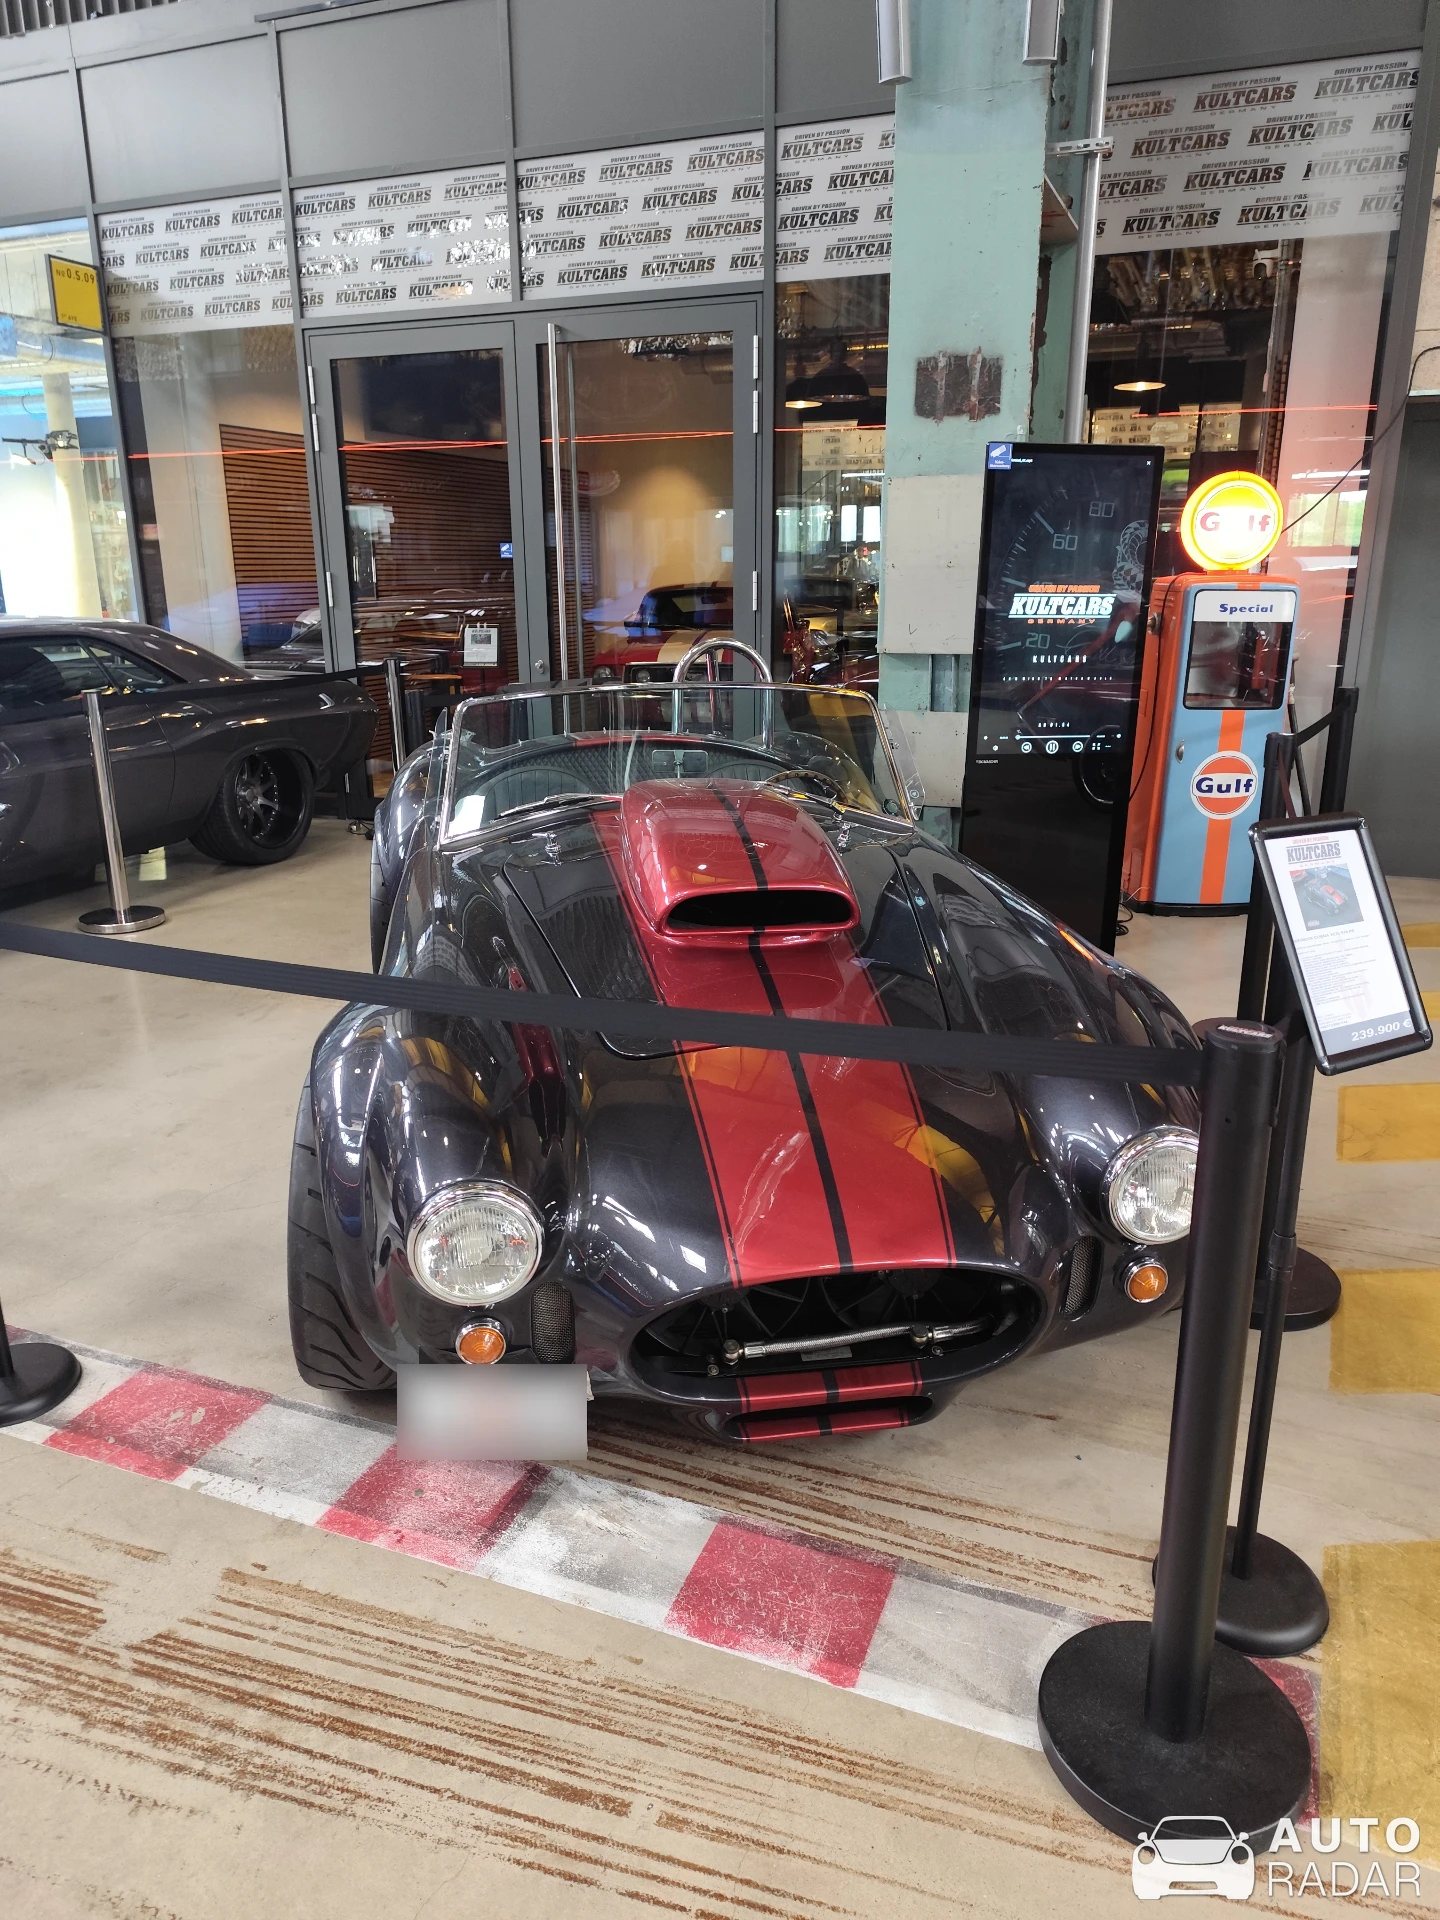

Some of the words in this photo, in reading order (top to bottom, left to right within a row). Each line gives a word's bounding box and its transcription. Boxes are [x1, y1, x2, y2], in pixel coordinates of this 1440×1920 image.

[1314, 70, 1419, 96] KULTCARS
[1194, 84, 1296, 110] KULTCARS
[1248, 118, 1353, 144] KULTCARS
[781, 135, 864, 158] KULTCARS
[1131, 132, 1230, 156] KULTCARS
[687, 148, 765, 170] KULTCARS
[518, 169, 586, 189] KULTCARS
[599, 159, 673, 180] KULTCARS
[1184, 165, 1285, 189] KULTCARS
[295, 197, 356, 215] KULTCARS
[368, 188, 432, 207] KULTCARS
[642, 189, 717, 209] KULTCARS
[231, 206, 285, 223] KULTCAR
[557, 199, 628, 218] KULTCARS
[1238, 199, 1341, 223] KULTCARS
[165, 214, 220, 231] KULTCARS
[686, 219, 762, 239] KULTCARS
[778, 209, 859, 230] KULTCARS
[1123, 210, 1220, 233] KULTCARS
[102, 222, 154, 239] KULTCARS
[599, 228, 672, 247] KULTCARS
[135, 247, 189, 264] KULTCARS
[557, 266, 628, 284] KULTCARS
[641, 258, 715, 276] KULTCARS
[106, 279, 159, 295] KULTCARS
[170, 273, 225, 289] KULTCARS
[336, 287, 397, 303] KULTCARS
[140, 305, 194, 320] KULTCARS
[204, 299, 260, 315] KULTCARS
[1089, 501, 1115, 518] 80
[1199, 511, 1272, 532] Glf
[1053, 533, 1078, 551] 60
[1009, 596, 1116, 615] KULTCARS
[1219, 603, 1274, 615] Special
[1025, 632, 1051, 649] 20
[1195, 776, 1254, 794] Gulf
[1286, 842, 1341, 863] KULTCARS
[1351, 1021, 1400, 1042] 239.900
[1402, 1018, 1412, 1028] €
